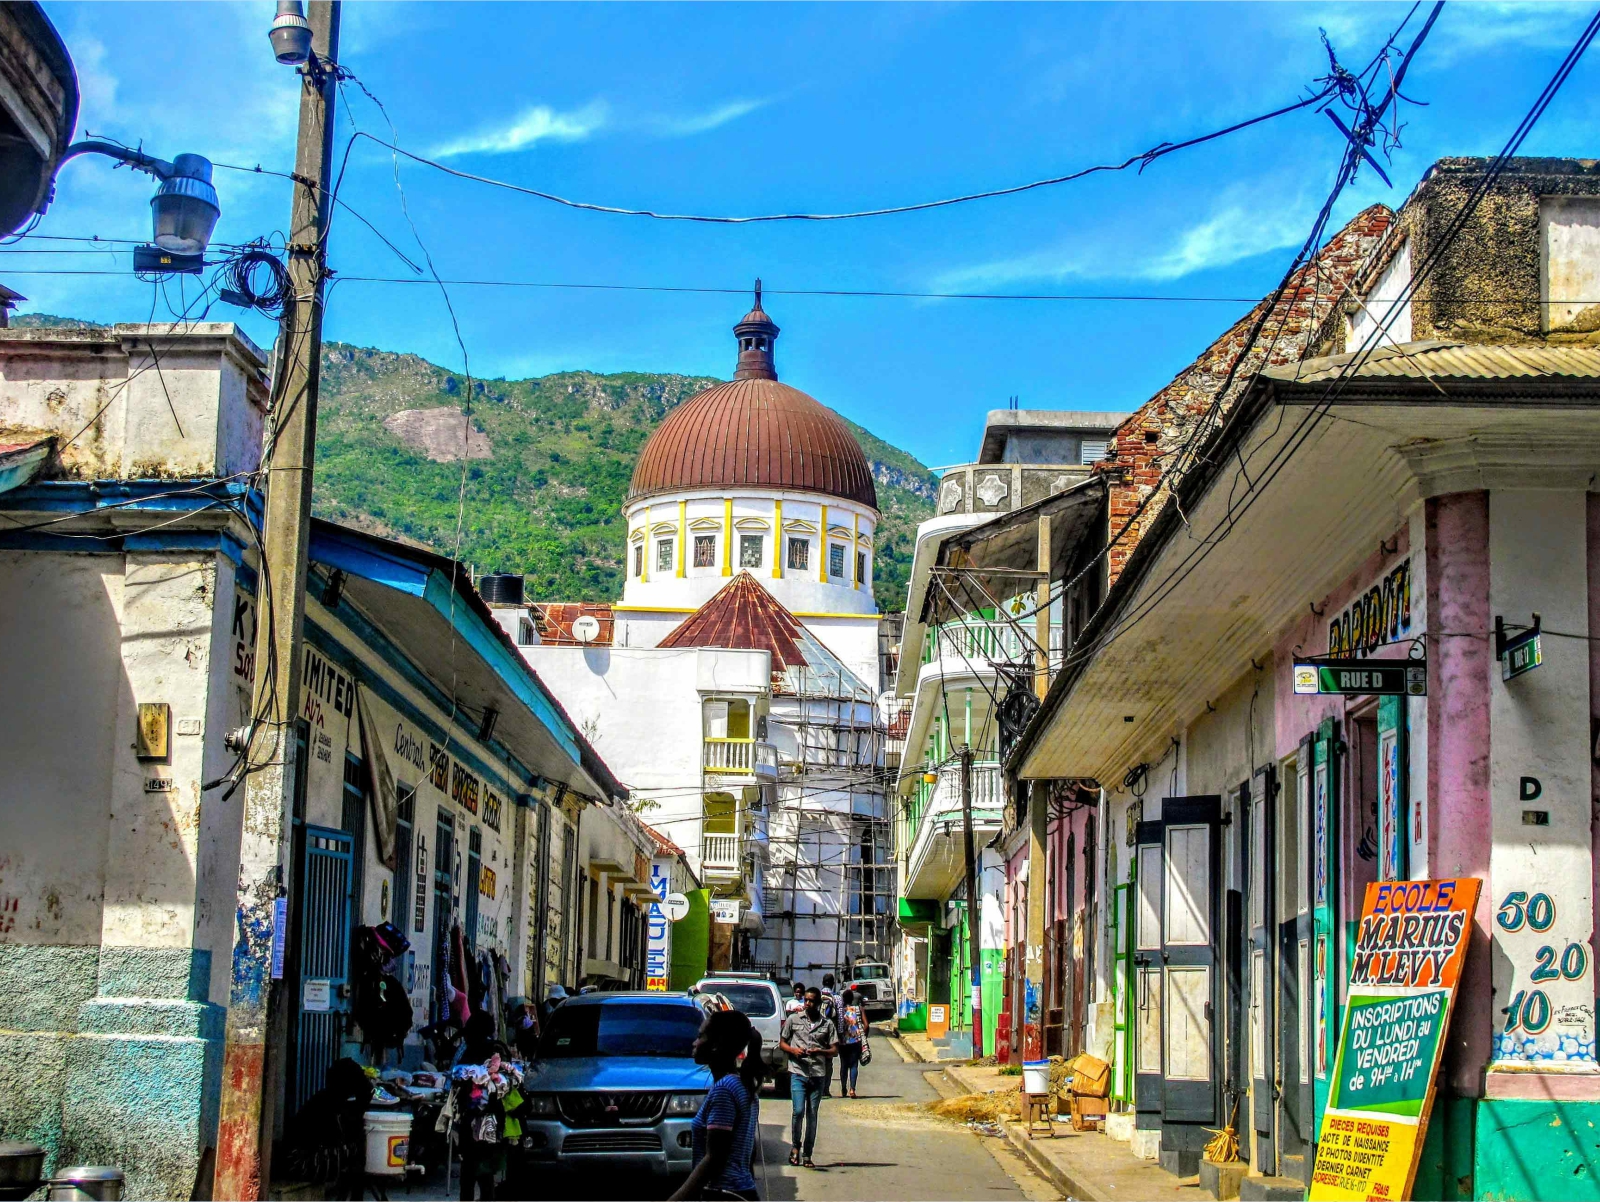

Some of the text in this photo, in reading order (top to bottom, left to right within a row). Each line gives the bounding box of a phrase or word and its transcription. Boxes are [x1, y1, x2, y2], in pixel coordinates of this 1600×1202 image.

[1514, 651, 1523, 668] RUE
[1340, 672, 1383, 688] RUE D
[1519, 776, 1542, 800] D
[1373, 881, 1456, 914] ECOLE
[1496, 890, 1556, 933] 50
[1357, 909, 1466, 951] MARIUS
[1530, 942, 1588, 984] 20
[649, 978, 666, 986] AR
[1351, 994, 1441, 1030] INSCRIPTIONS
[1502, 989, 1552, 1035] 10
[1352, 1020, 1431, 1050] DU LUNDI au
[1357, 1039, 1420, 1069] VENDREDI
[1349, 1071, 1364, 1091] de
[1356, 1122, 1390, 1138] REQUISES
[1325, 1147, 1352, 1161] PHOTOS
[1342, 1135, 1352, 1147] DE
[1353, 1137, 1391, 1153] NAISSANCE
[1345, 1165, 1373, 1179] CARNET
